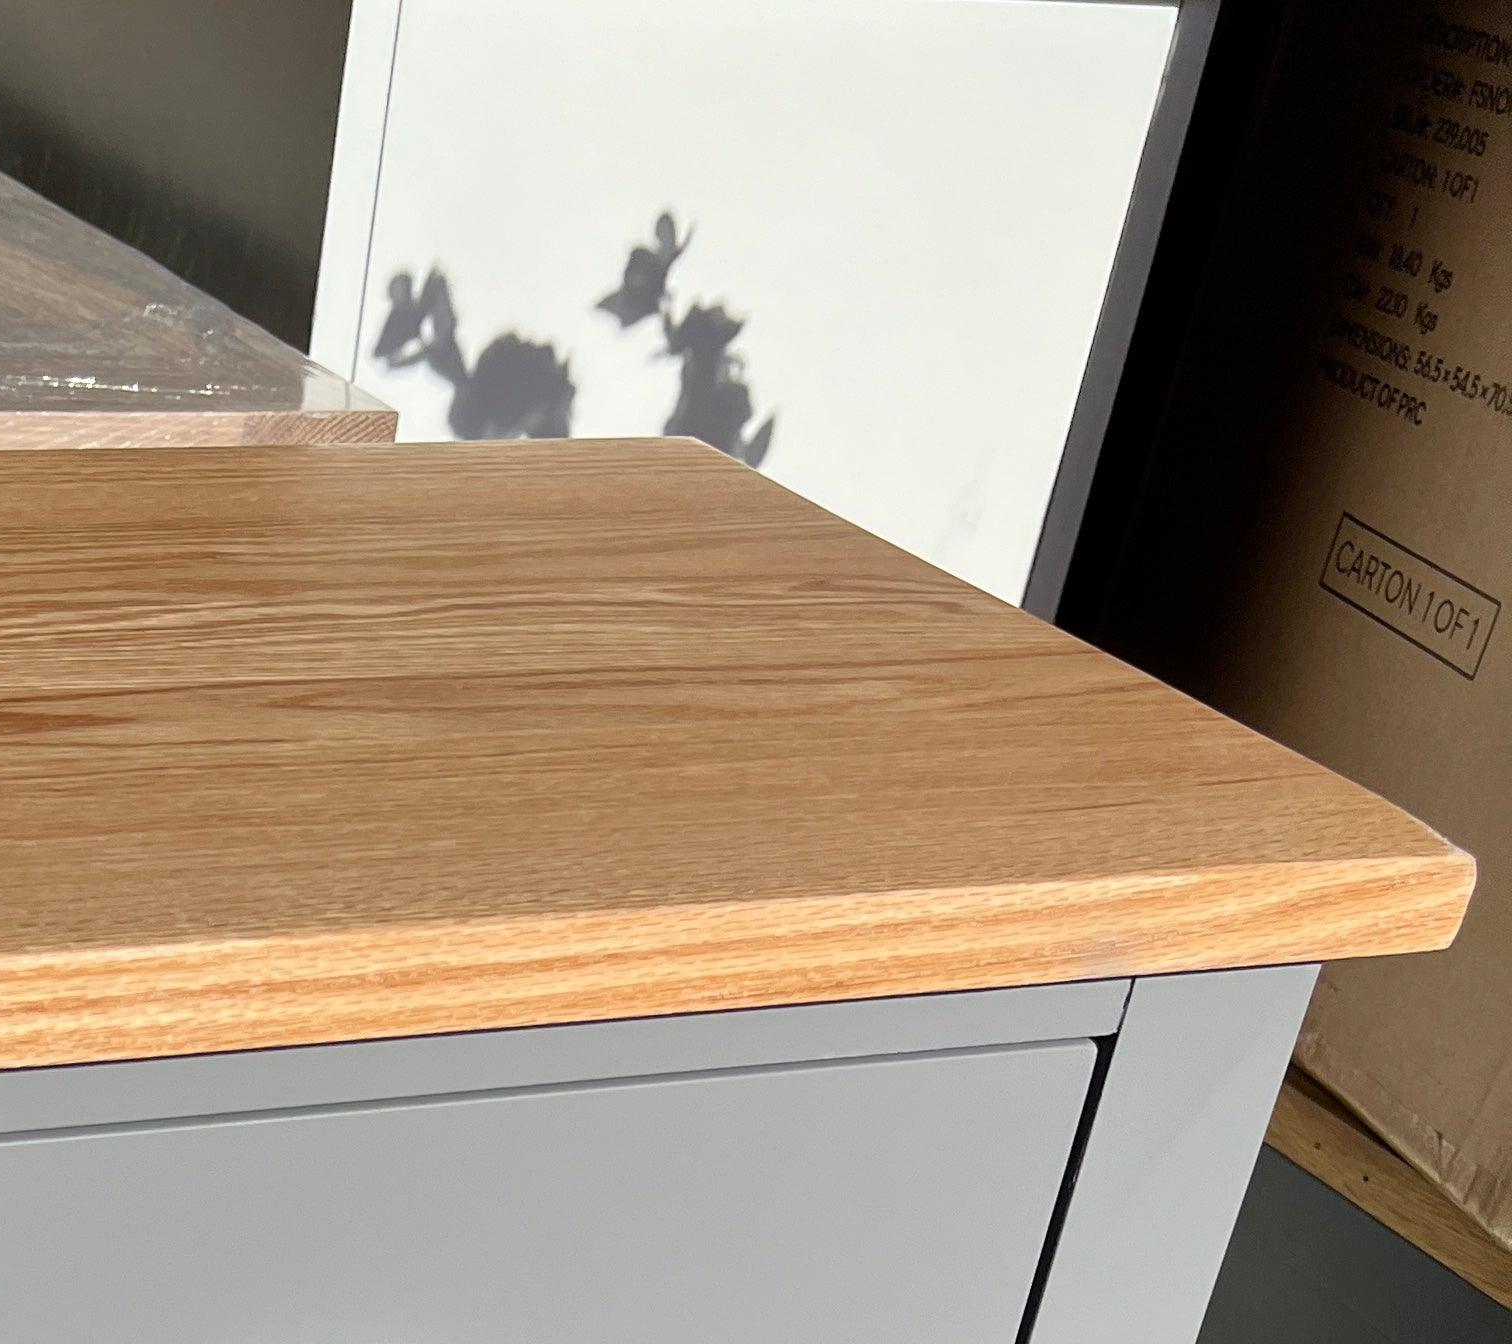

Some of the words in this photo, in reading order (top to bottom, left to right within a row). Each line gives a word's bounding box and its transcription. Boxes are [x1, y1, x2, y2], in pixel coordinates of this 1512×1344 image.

[1450, 171, 1474, 201] OF
[1470, 178, 1480, 204] 1
[1409, 206, 1418, 229] 1
[1428, 260, 1453, 293] Kgs
[1414, 302, 1439, 334] Kgs
[1377, 383, 1400, 410] OF
[1396, 393, 1427, 426] PRC
[1335, 540, 1422, 616] CARTON
[1422, 591, 1434, 622] 1
[1434, 599, 1470, 640] OF
[1466, 618, 1480, 650] 1
